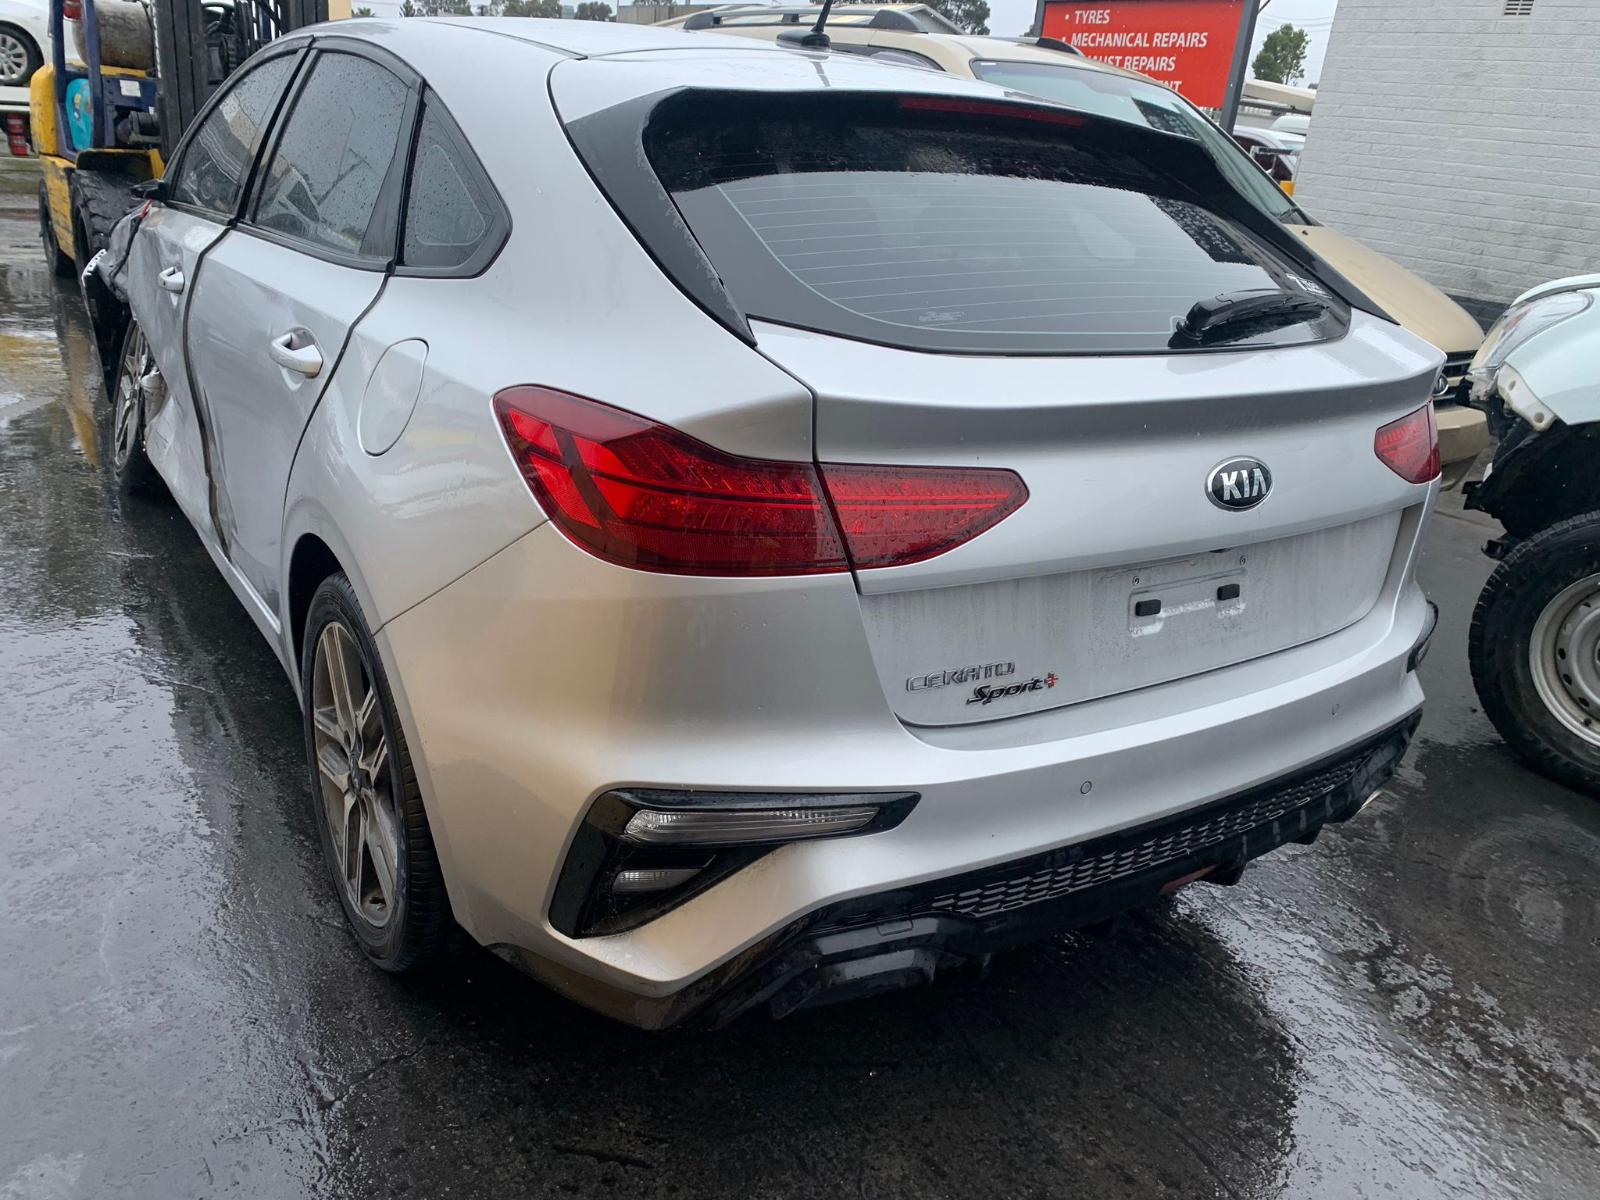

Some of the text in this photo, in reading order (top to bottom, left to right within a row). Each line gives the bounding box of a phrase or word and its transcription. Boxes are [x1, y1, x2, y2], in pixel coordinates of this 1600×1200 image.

[1075, 9, 1111, 25] TYRES
[1071, 32, 1209, 48] MECHANICAL REPAIRS
[1123, 56, 1177, 72] REPAIRS
[1220, 468, 1267, 501] KIA
[906, 661, 1016, 692] CERATO
